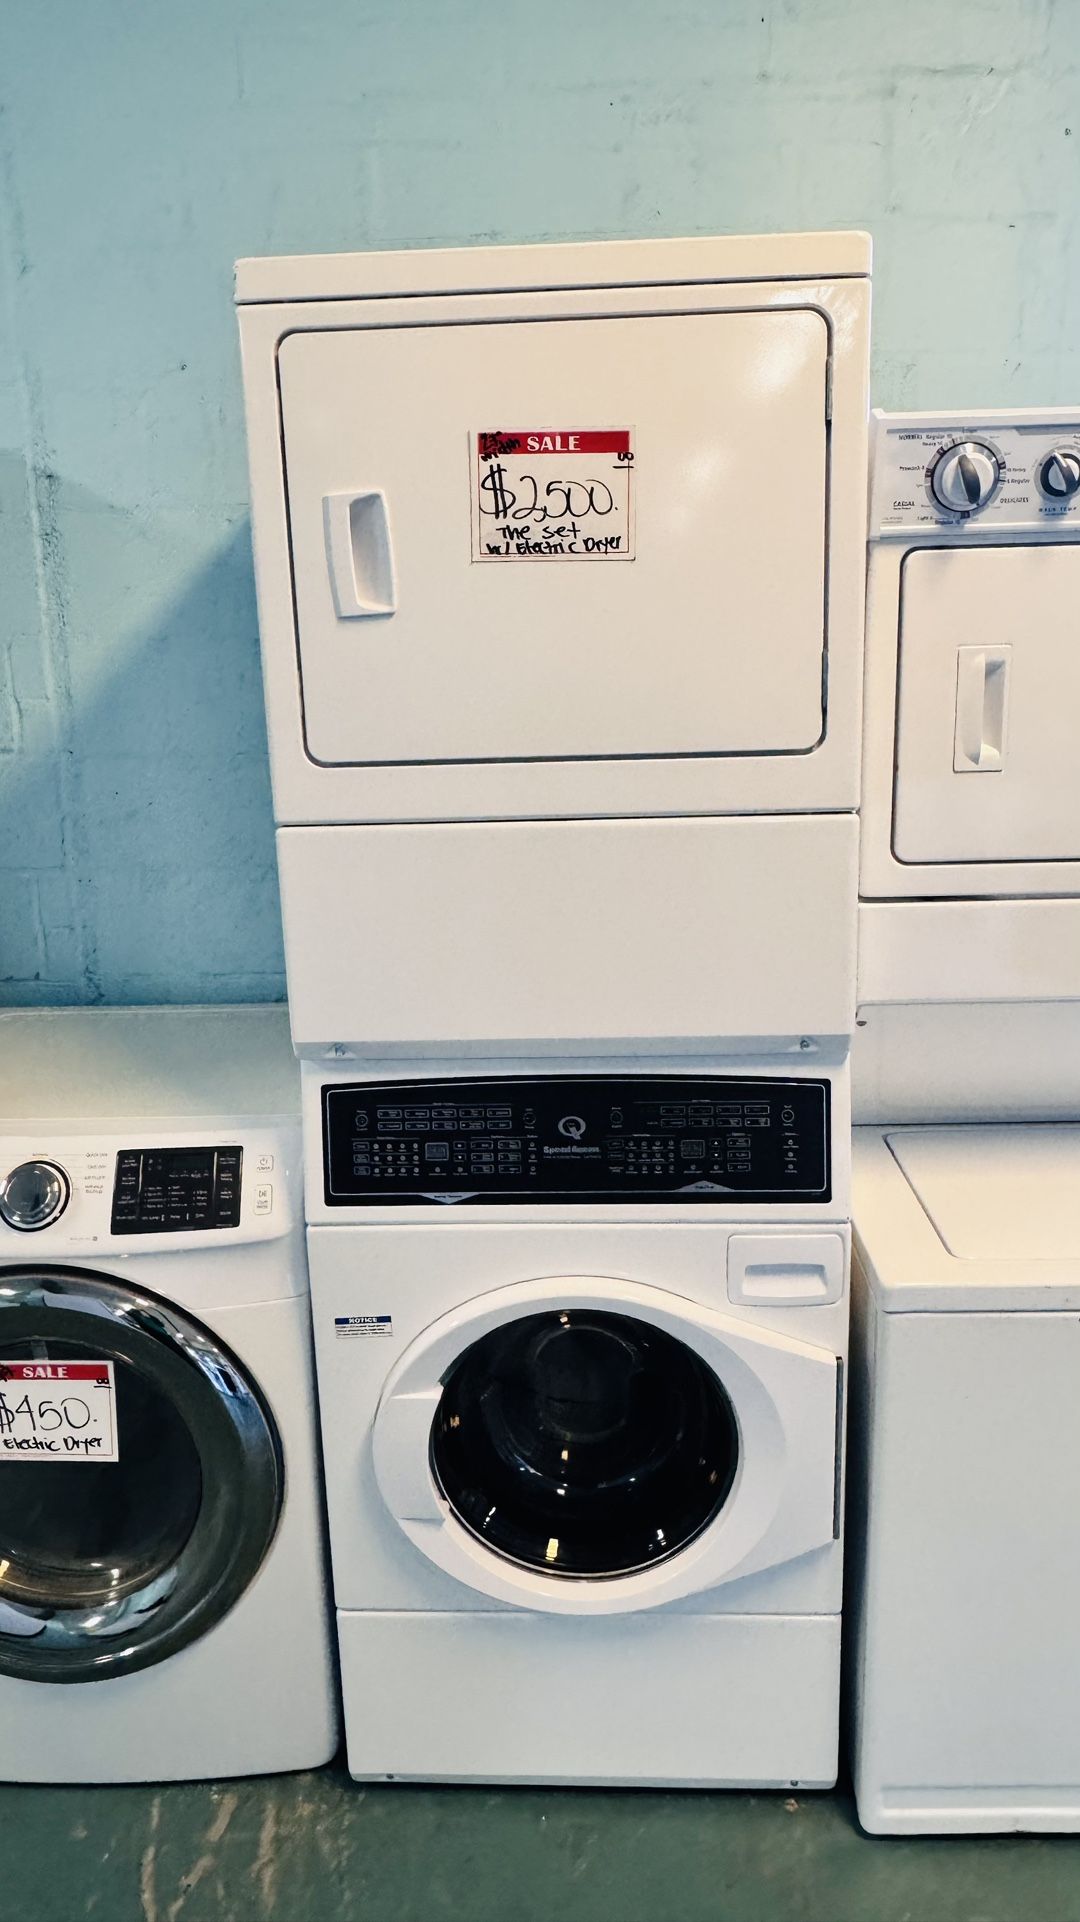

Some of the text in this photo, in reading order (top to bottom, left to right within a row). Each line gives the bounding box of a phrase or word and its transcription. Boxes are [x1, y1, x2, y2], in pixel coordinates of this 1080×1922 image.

[526, 435, 581, 451] SALE
[542, 522, 581, 540] set
[516, 539, 577, 555] Electric
[583, 536, 622, 555] Dryer
[22, 1366, 69, 1378] SALE
[3, 1435, 103, 1455] Electric Dryer
